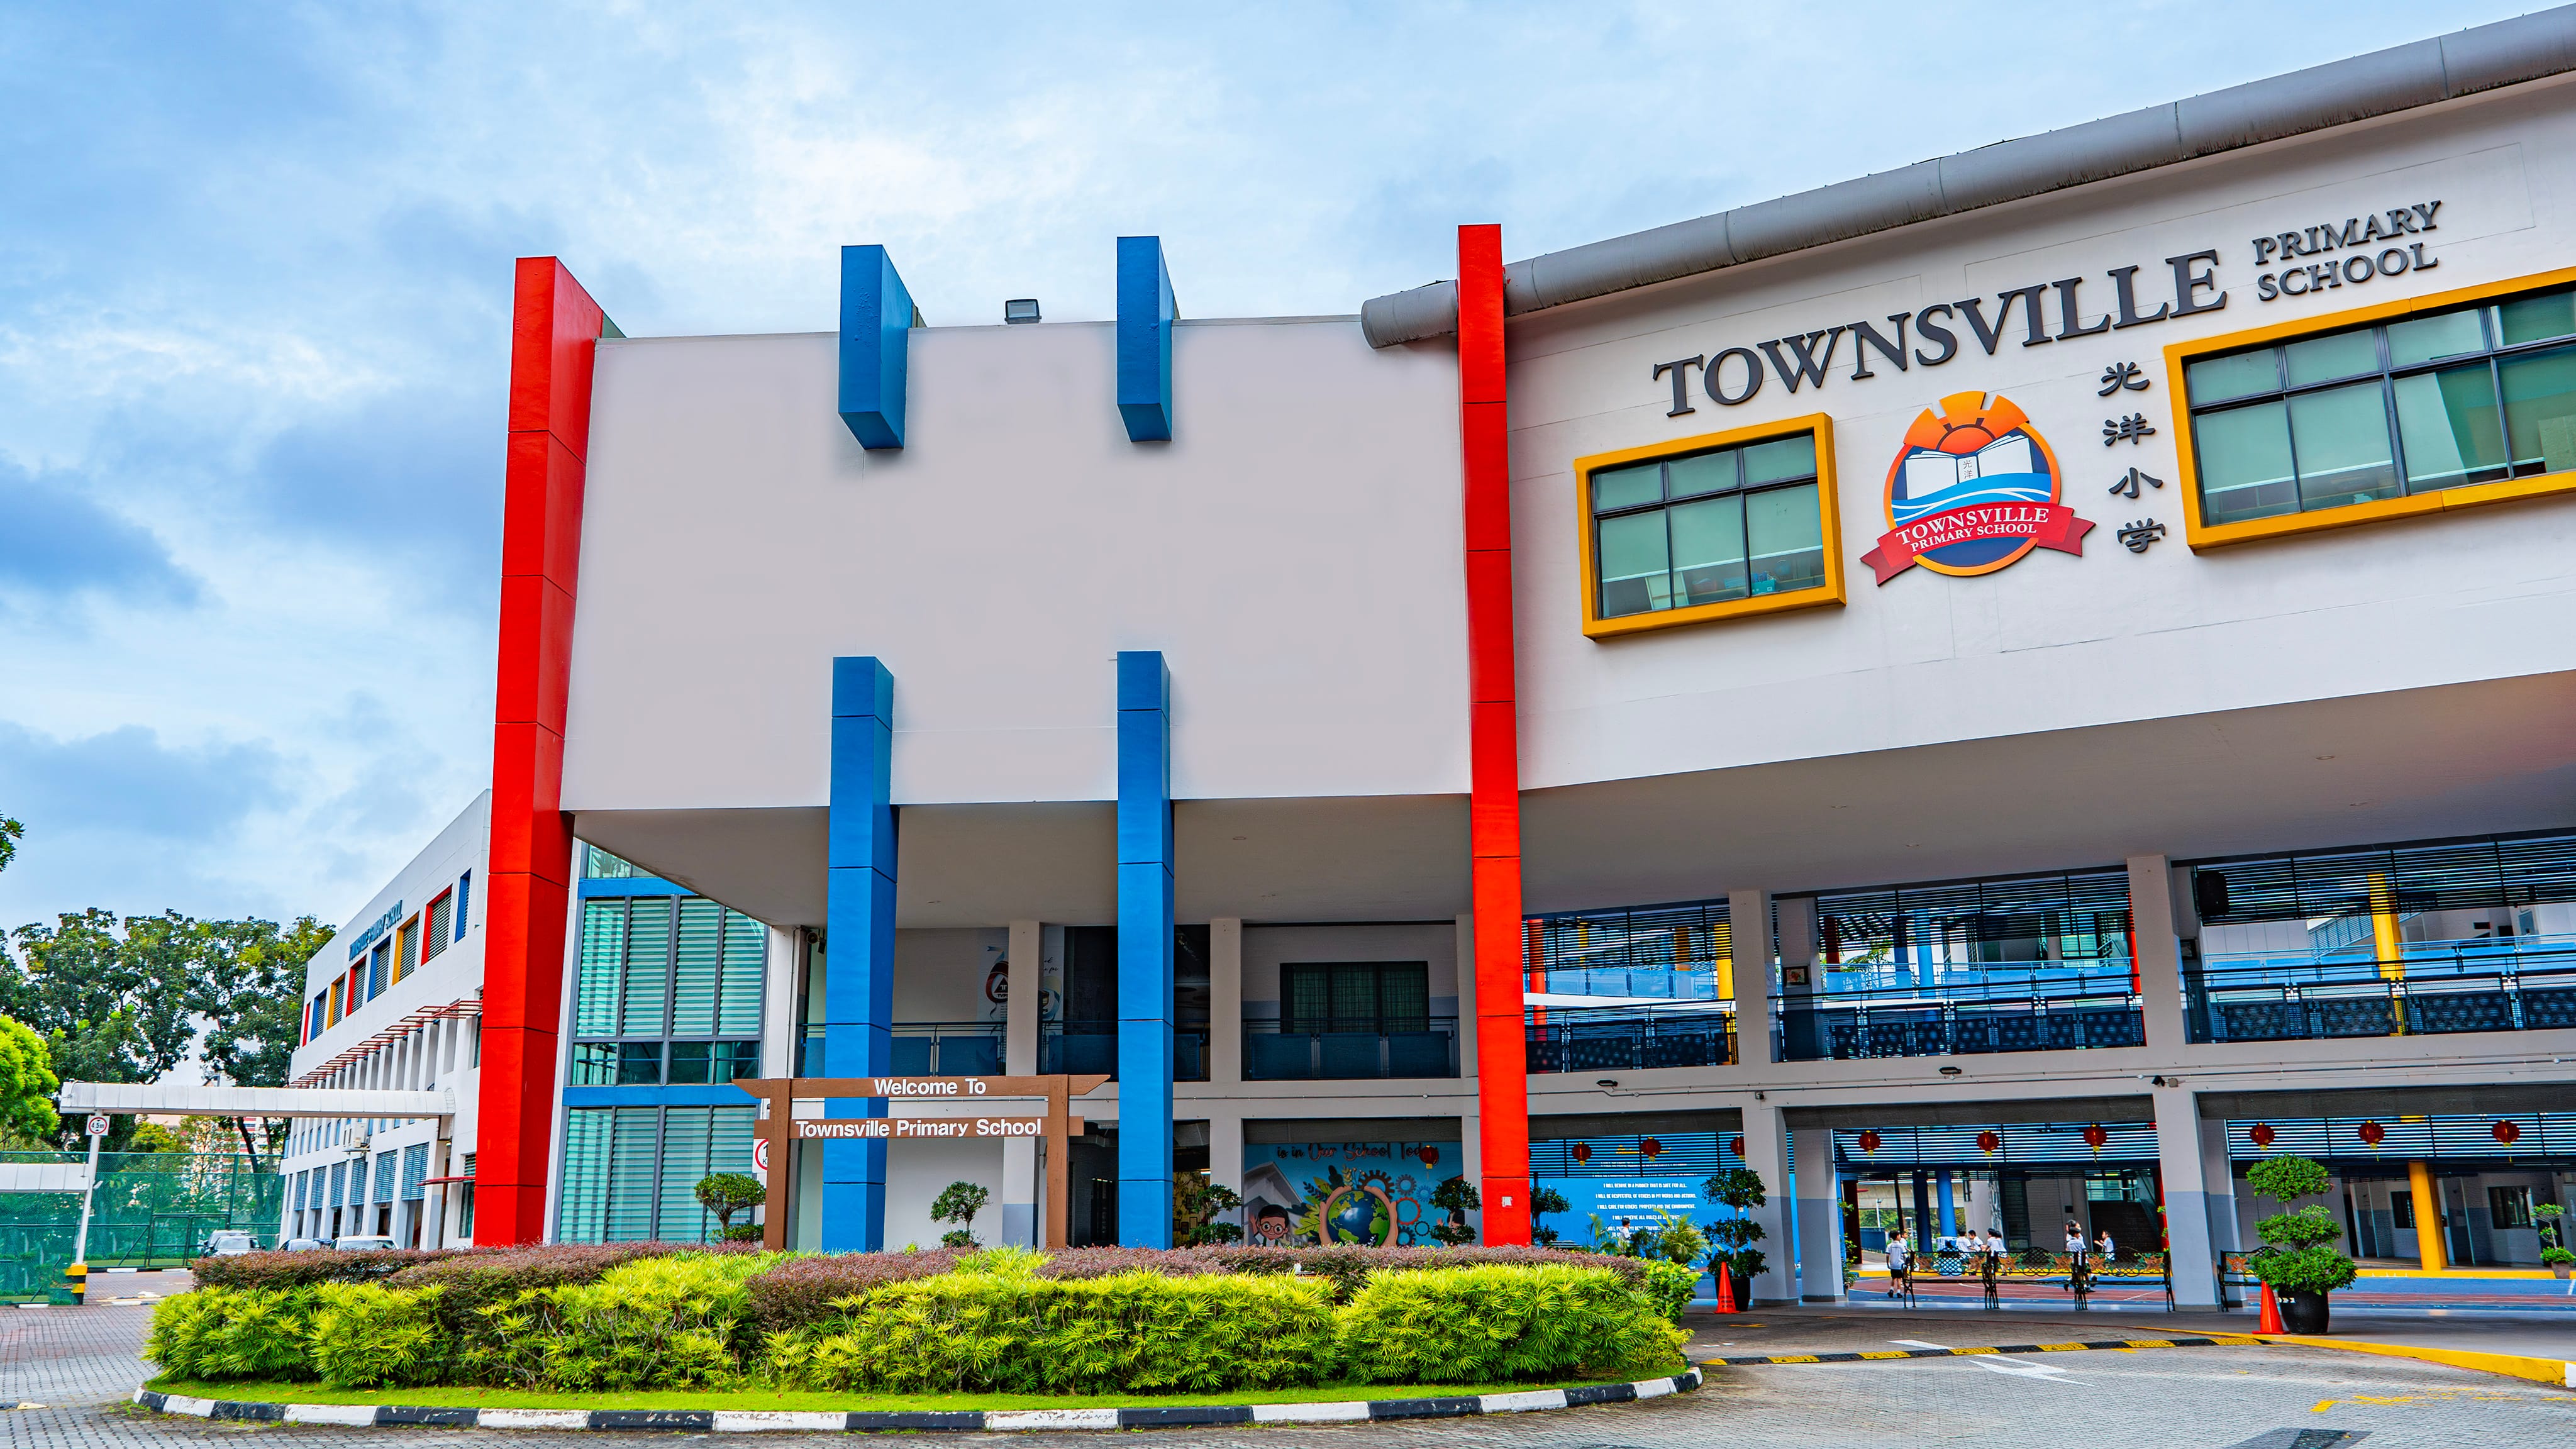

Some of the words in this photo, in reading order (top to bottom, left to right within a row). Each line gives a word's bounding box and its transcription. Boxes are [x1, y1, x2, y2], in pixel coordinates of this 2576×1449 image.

[2252, 200, 2441, 265] PRIMARY
[2257, 242, 2438, 301] SCHOOL
[1652, 248, 2227, 417] TOWNSVILLE
[2097, 362, 2165, 553] 光洋小学
[1896, 507, 2049, 545] TOWNSVILLE
[1910, 527, 1973, 552] PRIMARY
[1977, 523, 2037, 536] SCHOOL
[874, 1079, 957, 1096] Welcome
[965, 1078, 986, 1094] To
[796, 1121, 889, 1137] Townsville
[897, 1119, 969, 1138] Primary
[976, 1118, 1041, 1136] School
[1291, 1146, 1304, 1158] in
[1343, 1141, 1392, 1162] School
